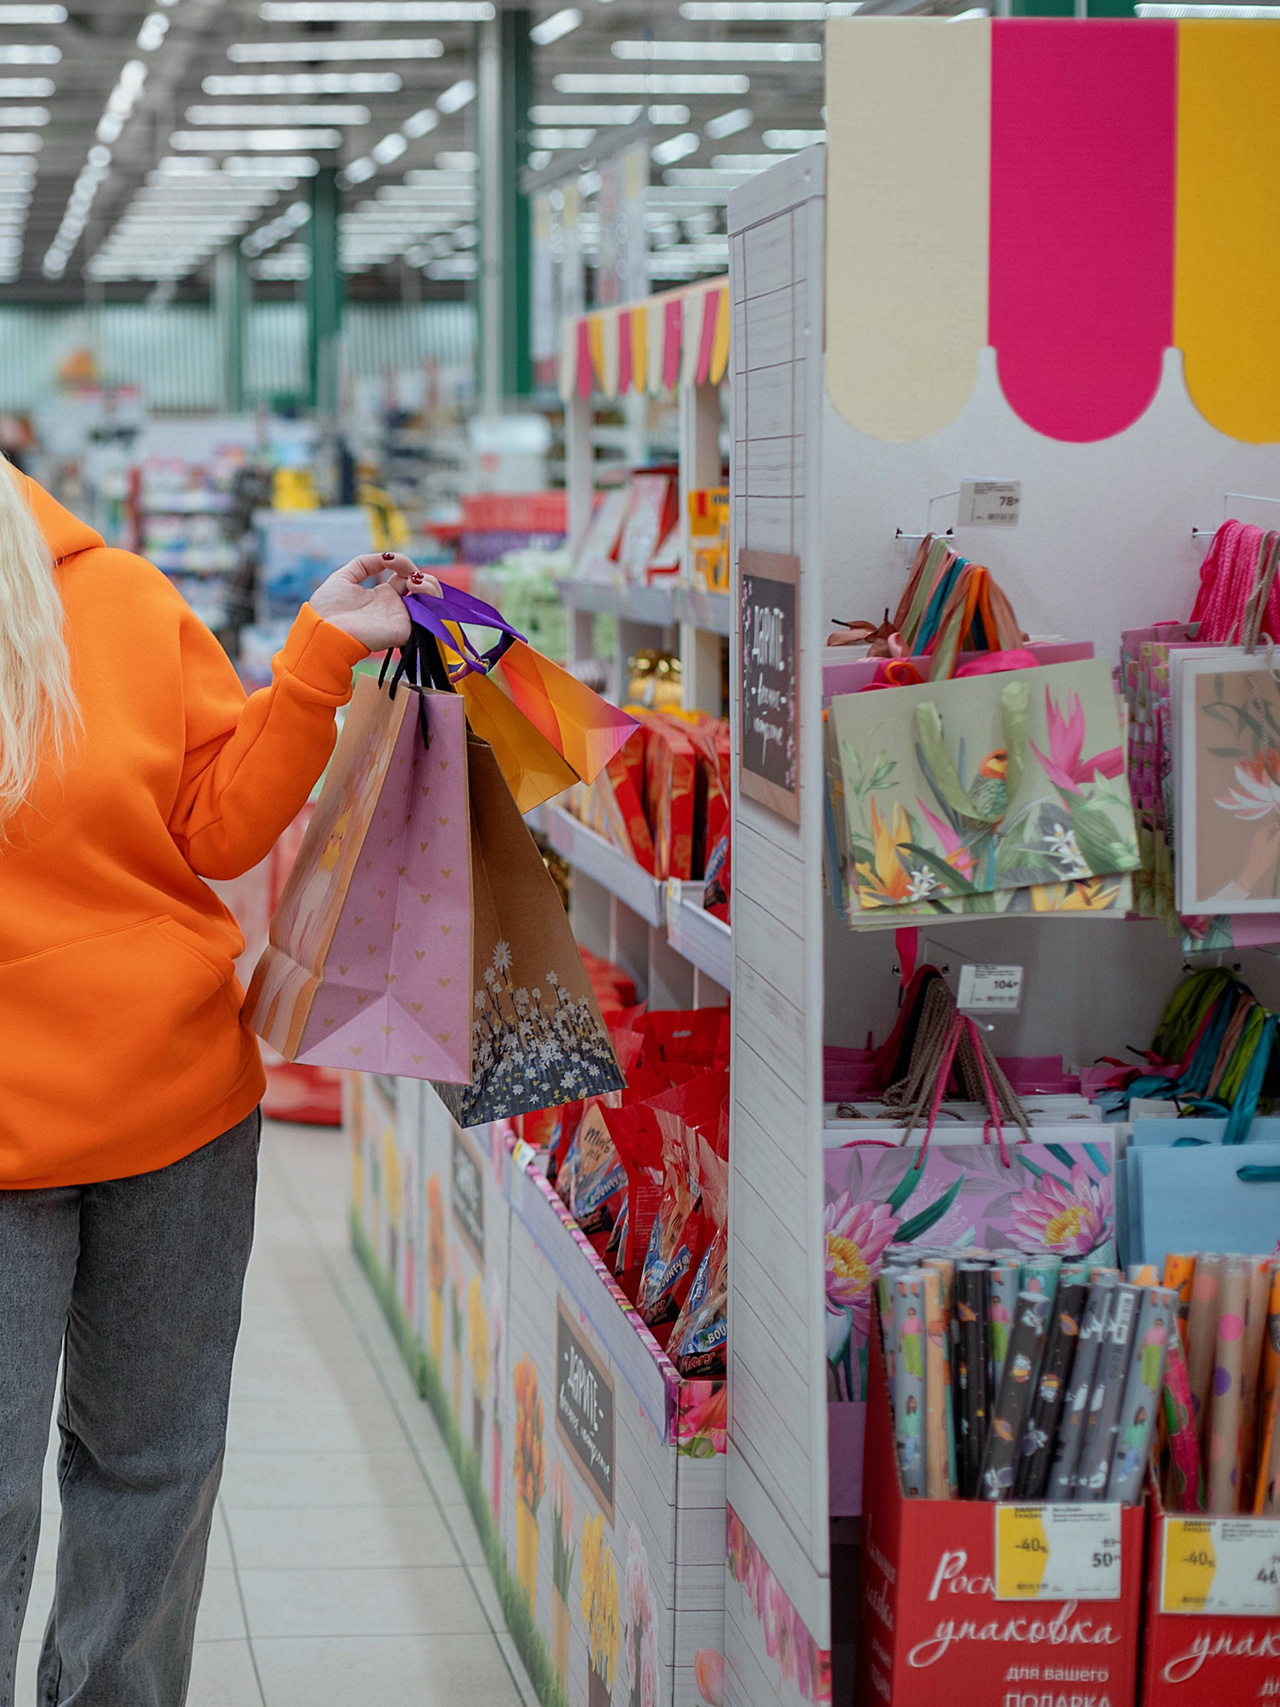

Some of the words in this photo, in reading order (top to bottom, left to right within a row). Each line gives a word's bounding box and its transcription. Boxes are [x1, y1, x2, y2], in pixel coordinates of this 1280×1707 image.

[707, 1325, 728, 1344] BOU
[908, 1599, 1121, 1668] упаковка
[1006, 1667, 1040, 1682] для
[1043, 1667, 1109, 1682] вашего
